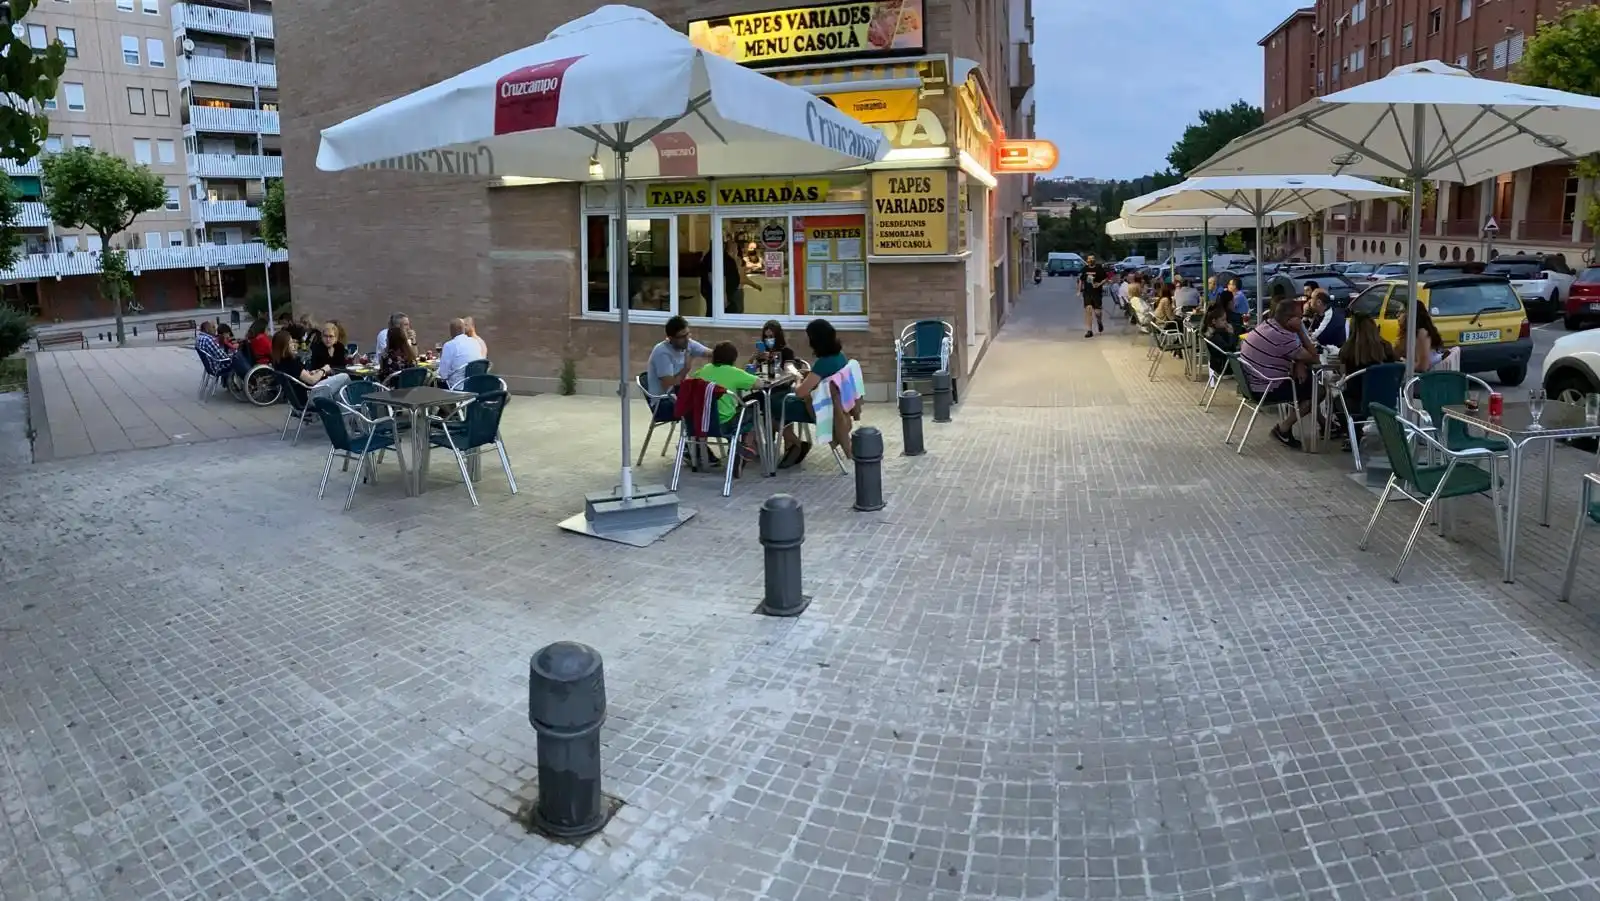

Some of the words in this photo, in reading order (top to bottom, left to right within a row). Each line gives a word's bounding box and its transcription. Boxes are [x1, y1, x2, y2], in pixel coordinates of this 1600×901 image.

[734, 14, 782, 36] TAPES
[786, 6, 870, 30] VARIADES
[744, 37, 790, 57] MENU
[793, 26, 860, 52] CASOLÀ
[501, 77, 558, 98] Cruzcampo
[888, 177, 931, 194] TAPES
[651, 190, 706, 205] TAPAS
[719, 186, 819, 204] VARIADAS
[875, 198, 945, 214] VARIADES
[879, 220, 926, 228] DESDEJUNIS
[813, 229, 861, 239] OFERTES
[1465, 333, 1471, 341] B
